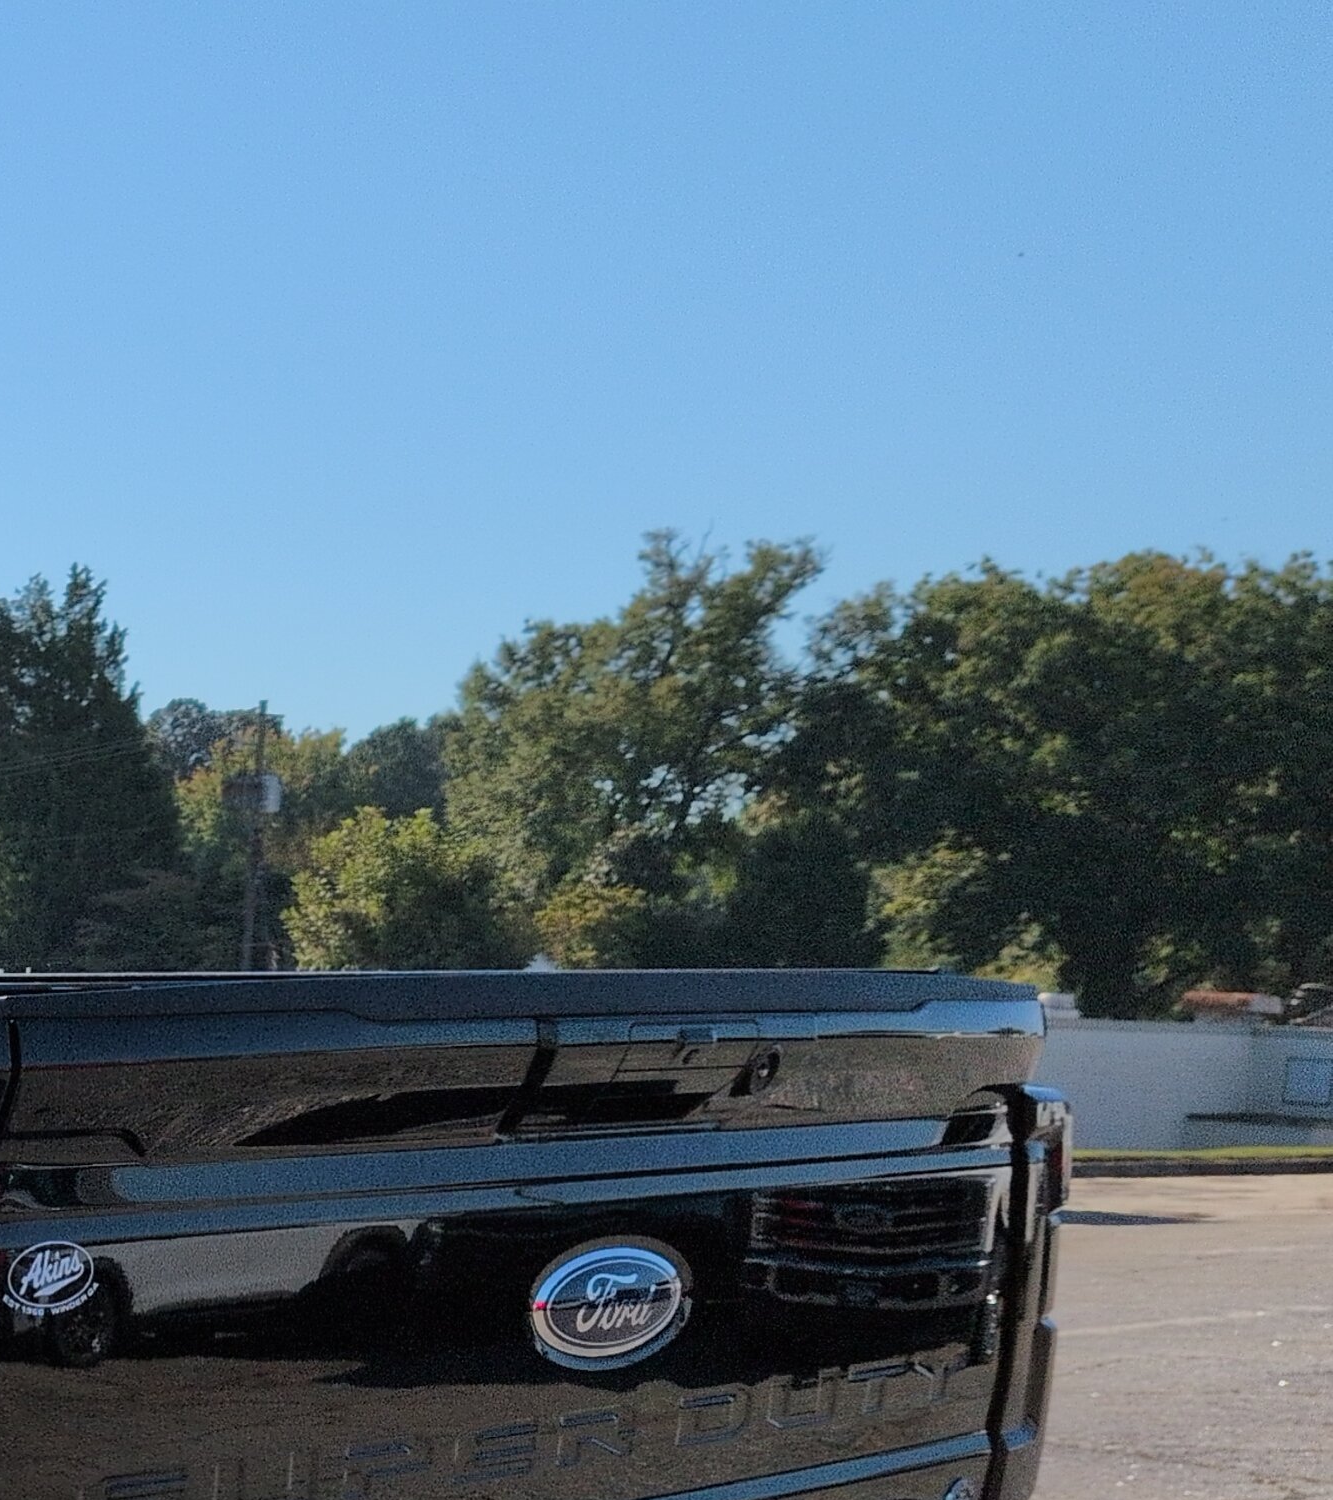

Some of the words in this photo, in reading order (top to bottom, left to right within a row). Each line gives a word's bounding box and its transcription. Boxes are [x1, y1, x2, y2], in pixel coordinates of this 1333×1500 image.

[19, 1249, 85, 1296] Akins
[575, 1272, 658, 1333] Ford
[675, 1349, 971, 1446] DUTY
